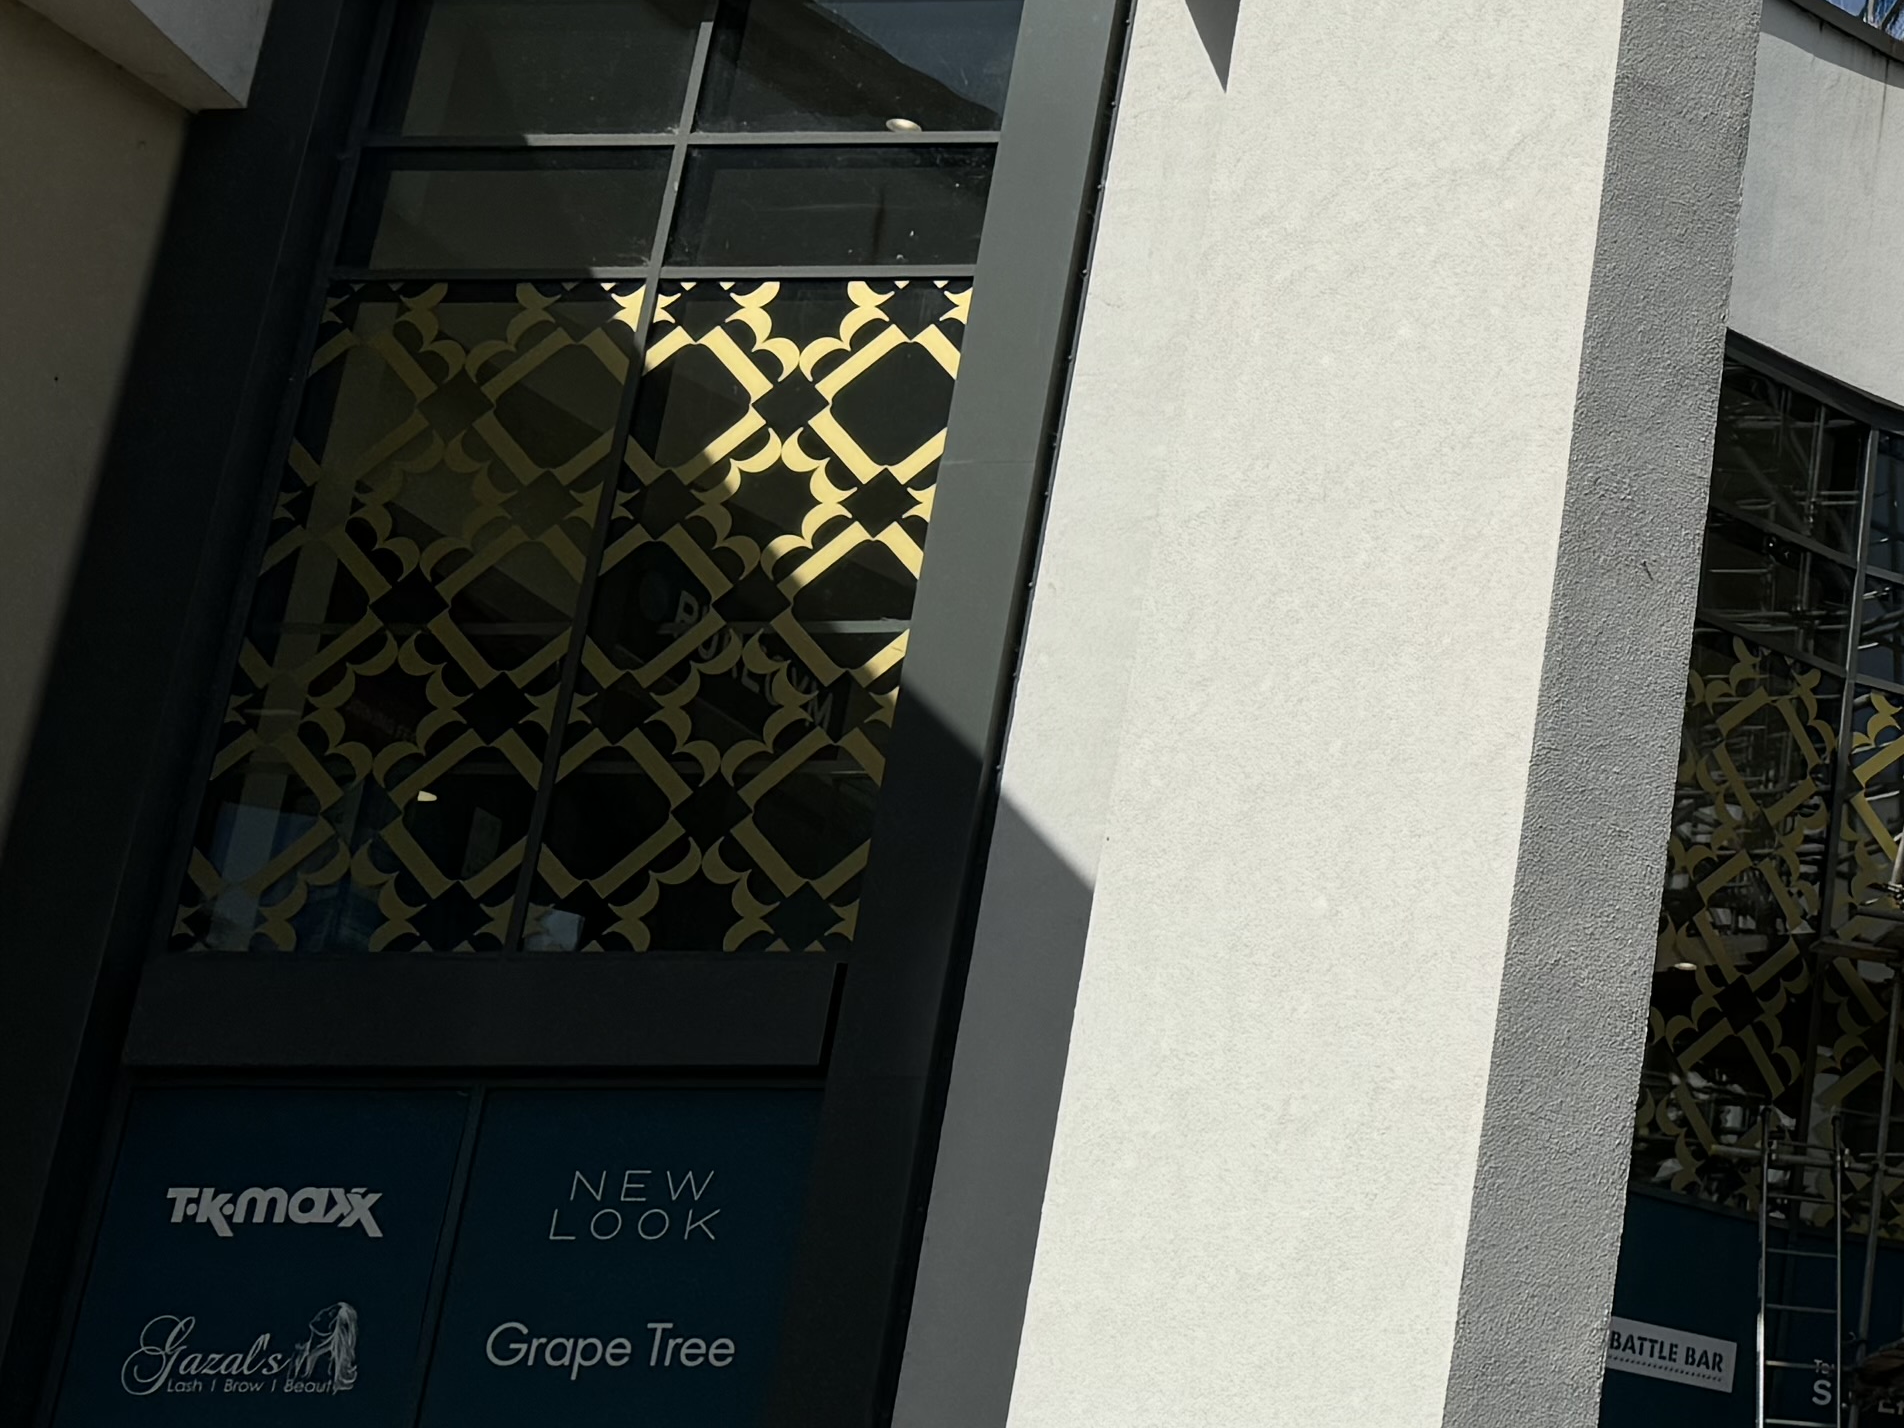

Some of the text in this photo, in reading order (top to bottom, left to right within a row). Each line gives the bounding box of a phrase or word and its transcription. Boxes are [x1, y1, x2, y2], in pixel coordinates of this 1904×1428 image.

[569, 1170, 717, 1203] NEW
[548, 1208, 721, 1241] LOOK
[485, 1321, 735, 1380] Grape Tree
[1609, 1330, 1723, 1373] BATTLE BAR
[167, 1378, 202, 1393] Lash
[223, 1378, 264, 1393] Brow
